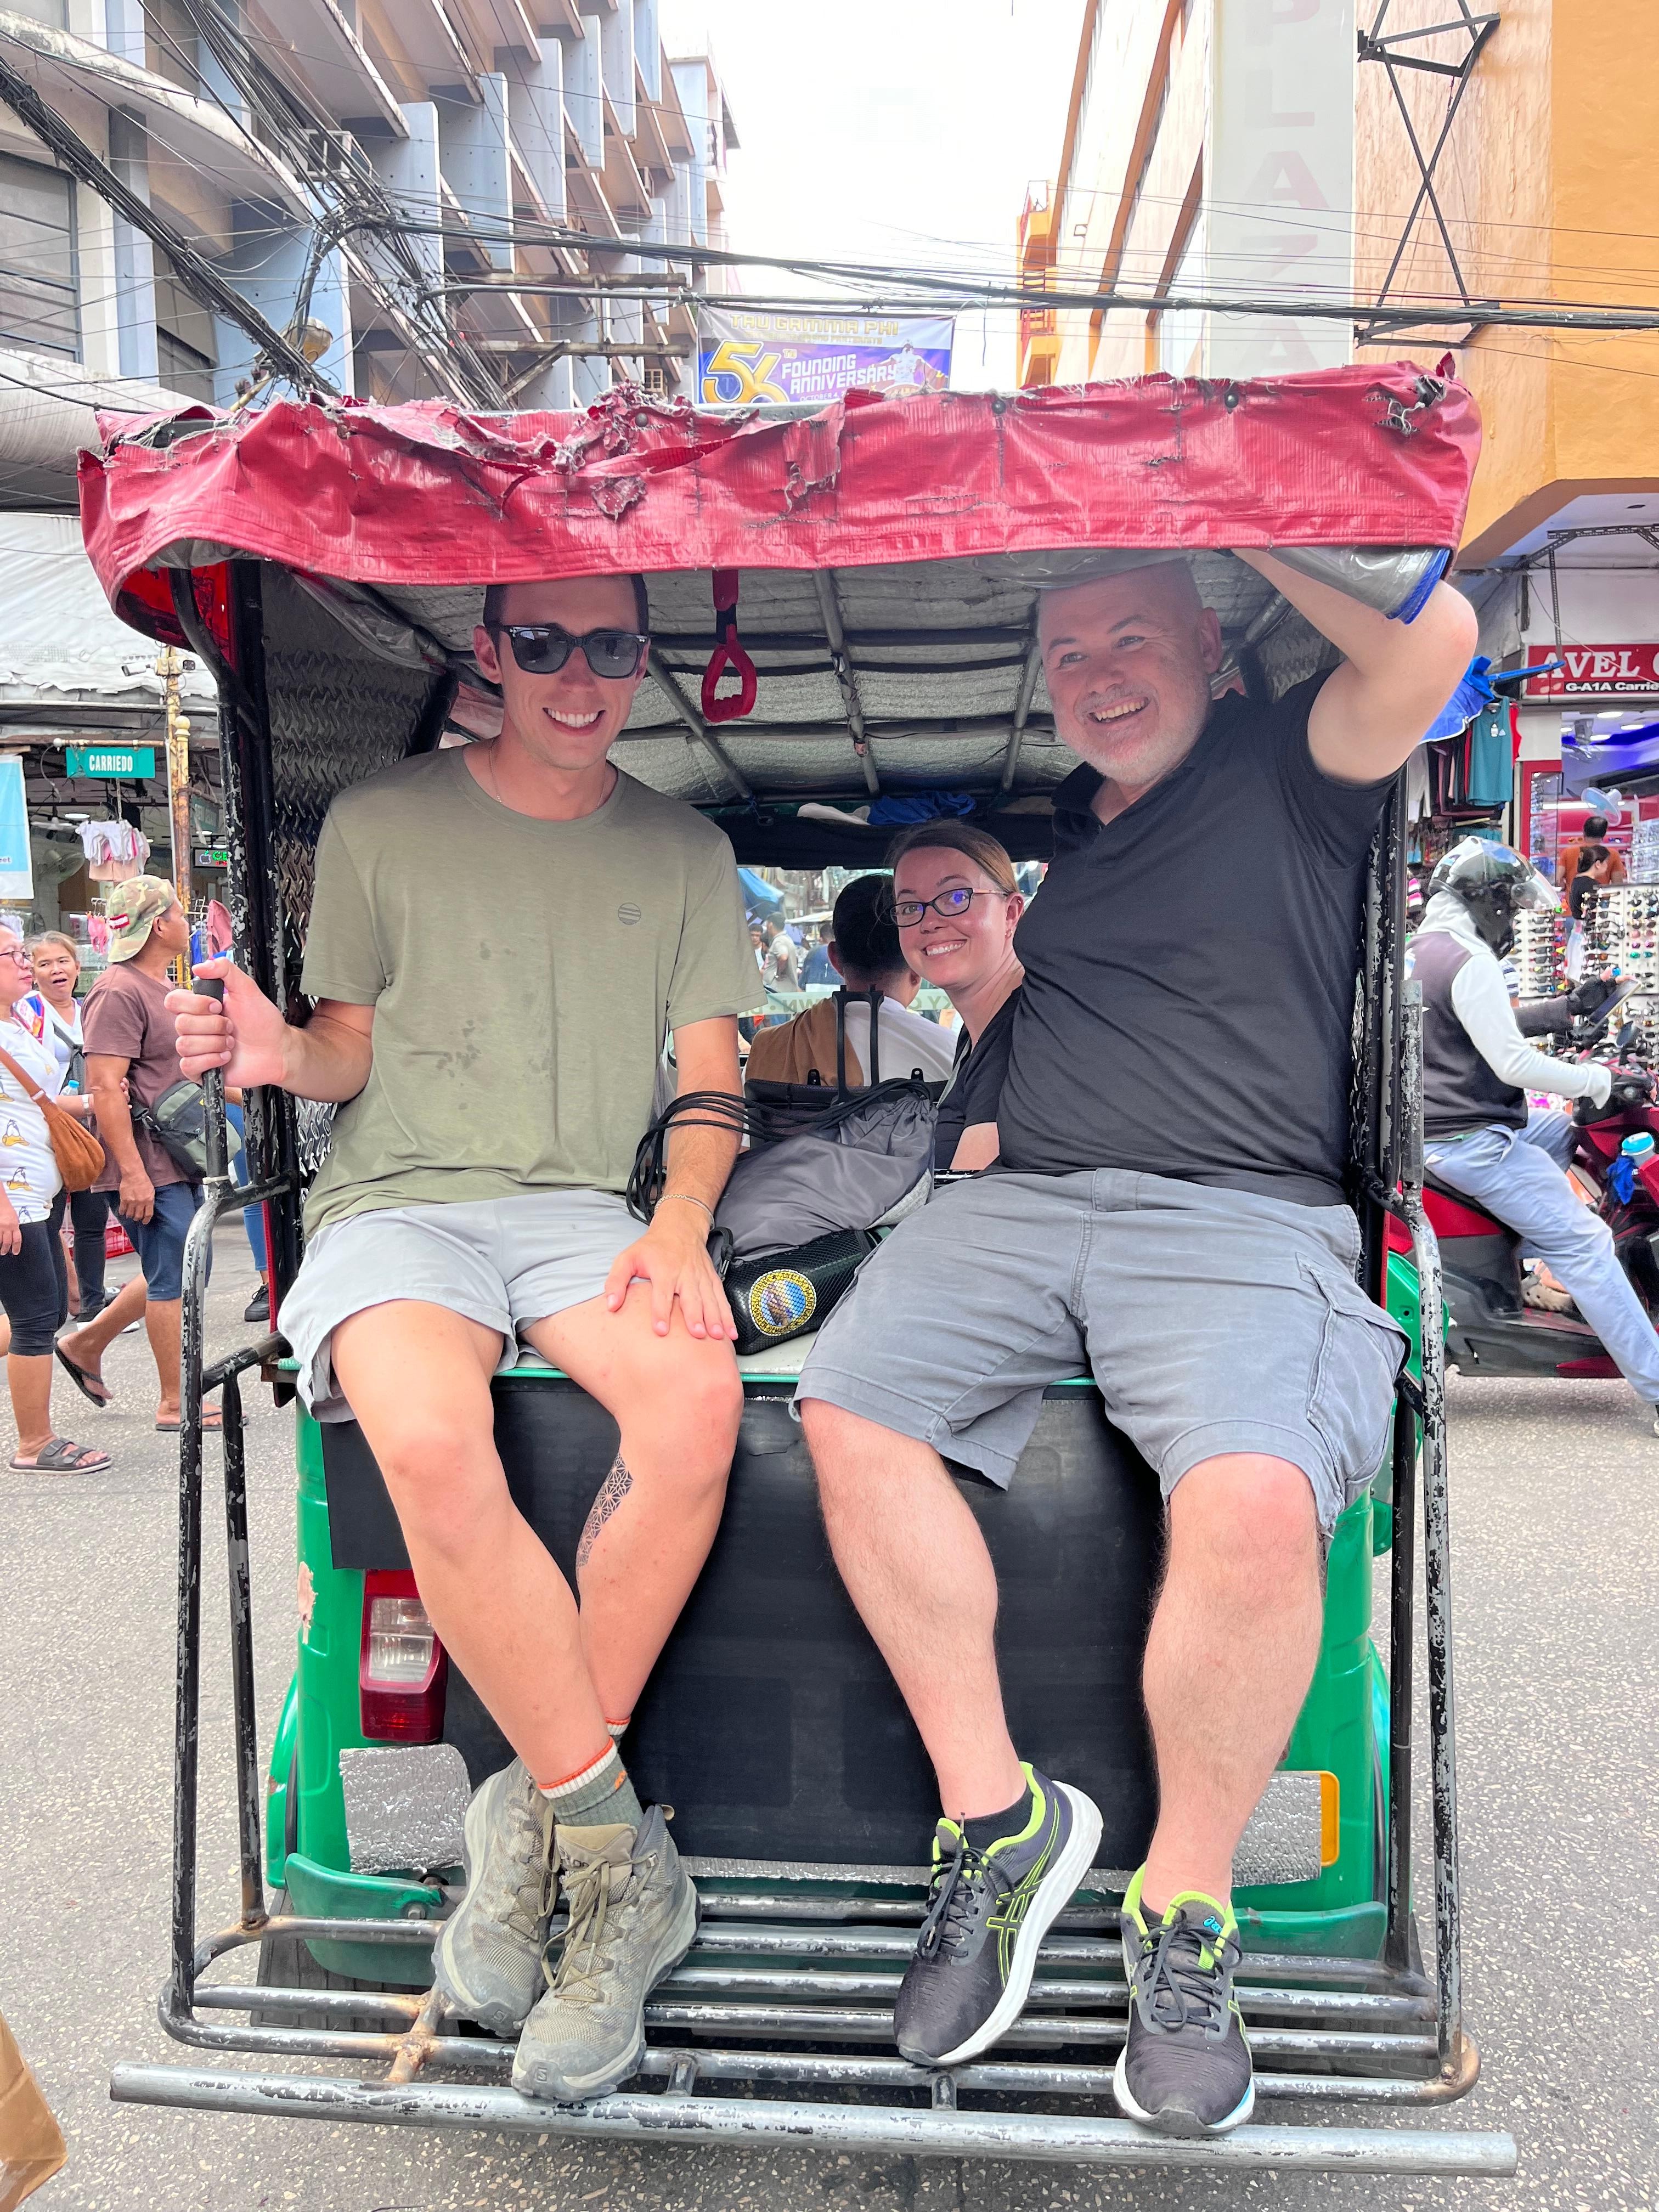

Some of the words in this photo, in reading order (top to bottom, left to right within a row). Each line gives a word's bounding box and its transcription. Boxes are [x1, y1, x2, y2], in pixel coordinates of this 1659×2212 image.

[729, 313, 769, 329] TAU
[775, 316, 859, 334] GAMMA
[865, 319, 899, 336] PHI
[702, 340, 790, 403] 56
[782, 354, 856, 380] FOUNDING
[791, 364, 896, 394] ANNIVERSARY
[800, 392, 832, 402] OCTOBER
[1537, 651, 1640, 678] AVEL
[89, 754, 133, 772] CARRIEDO
